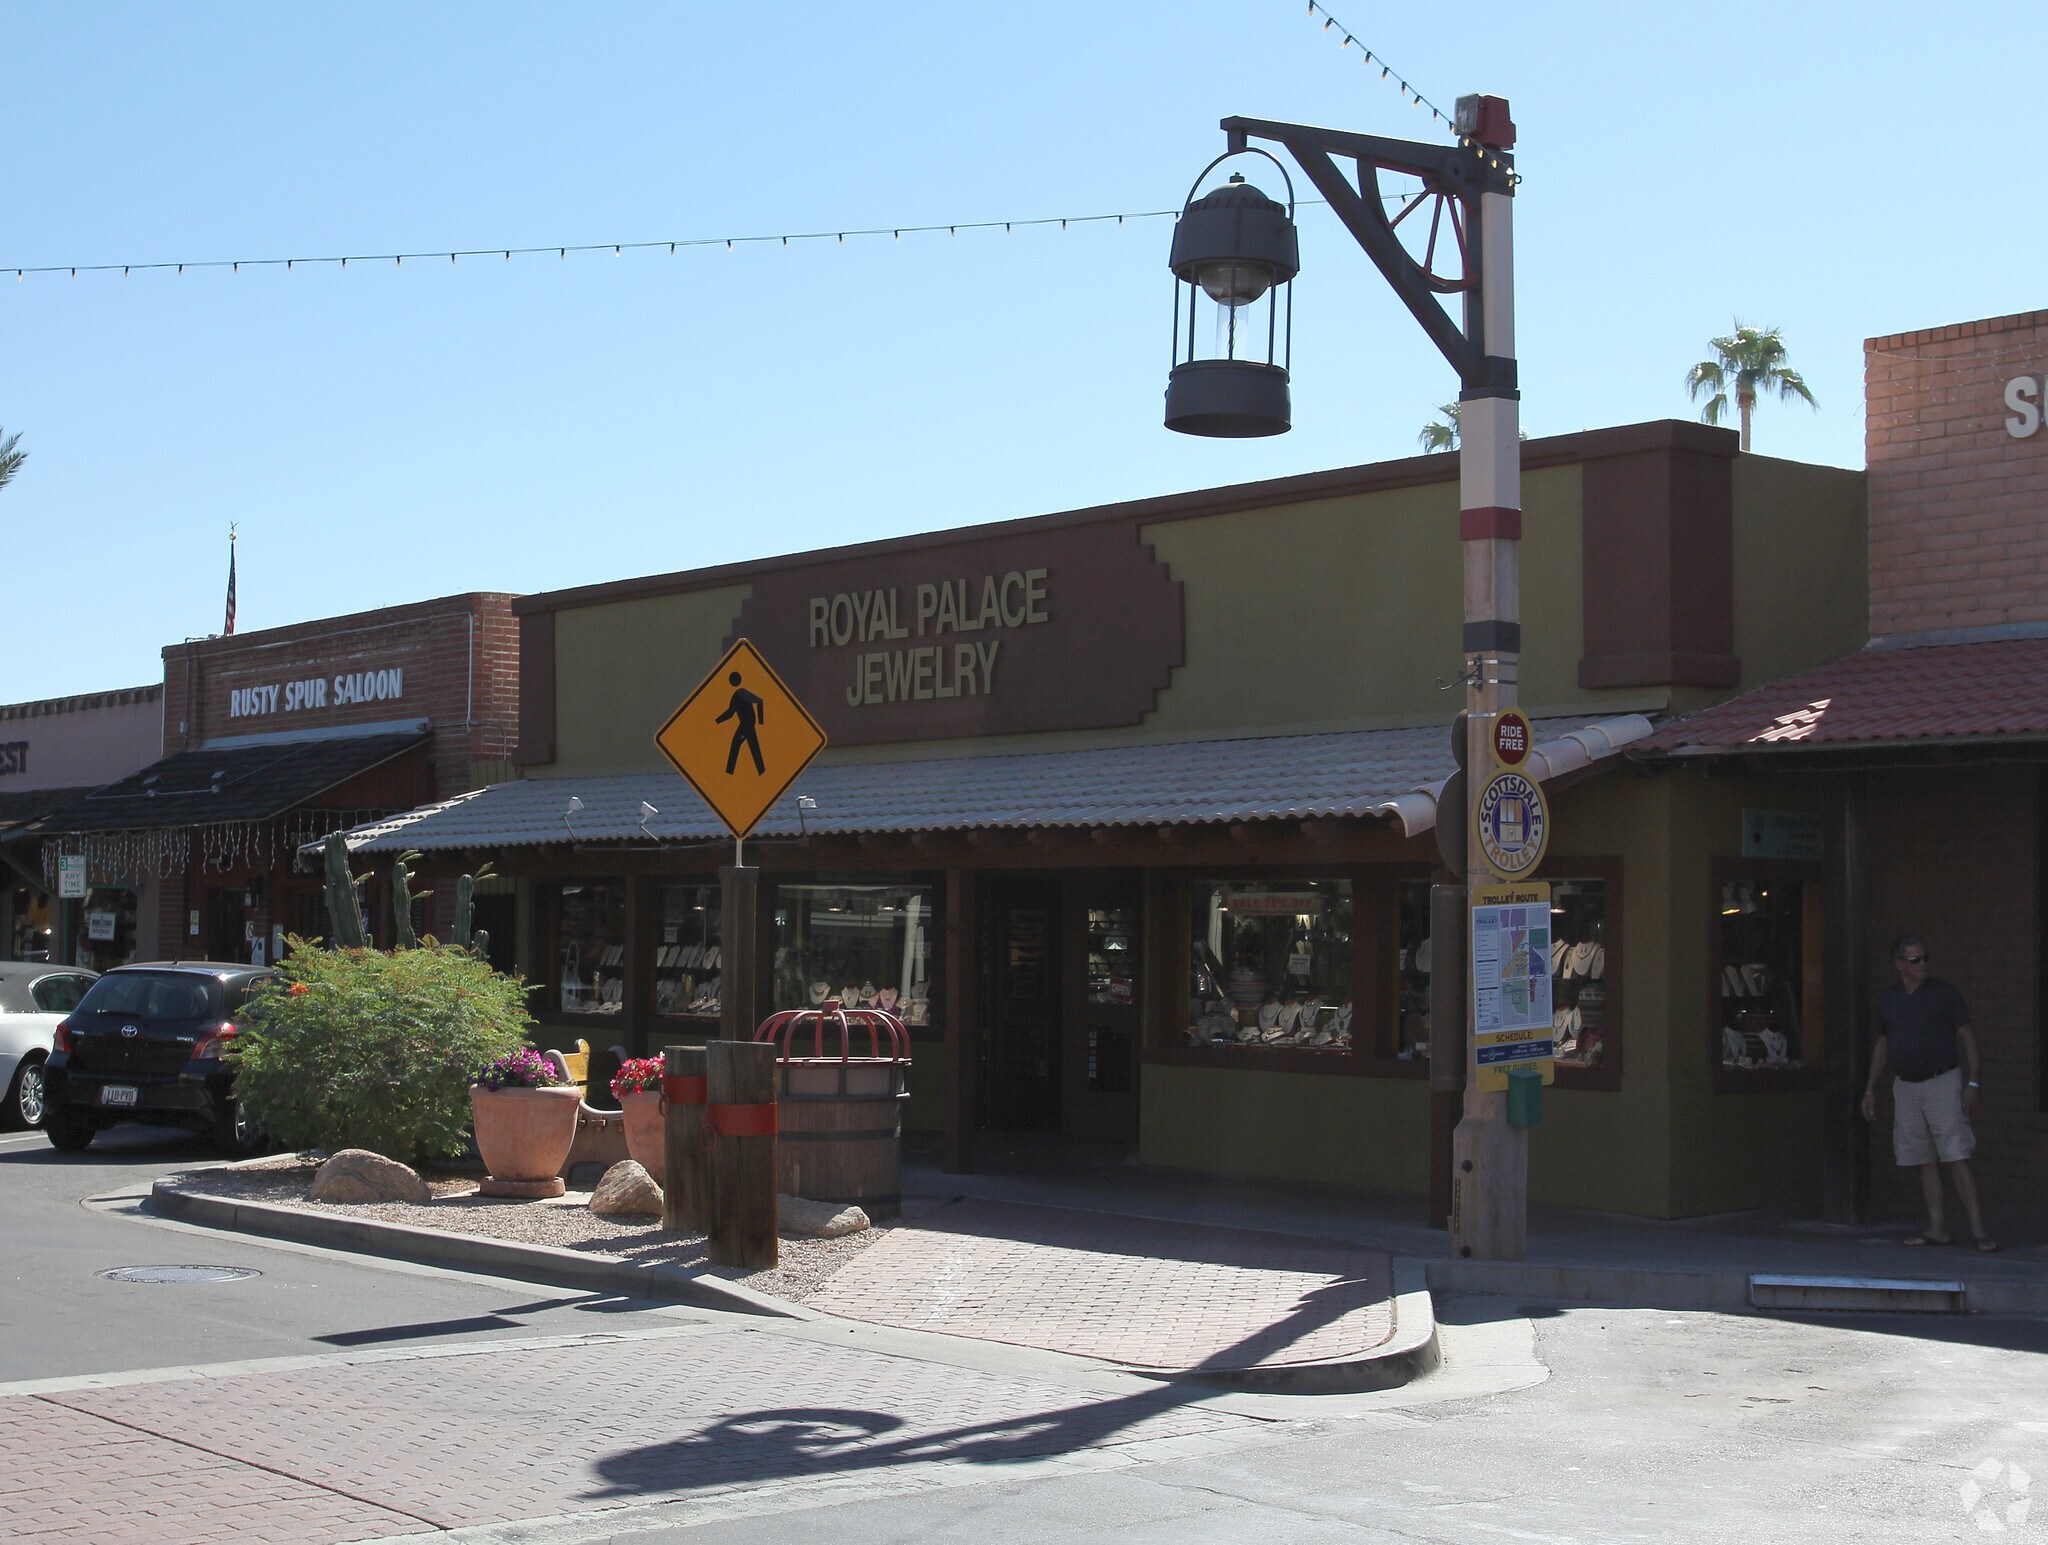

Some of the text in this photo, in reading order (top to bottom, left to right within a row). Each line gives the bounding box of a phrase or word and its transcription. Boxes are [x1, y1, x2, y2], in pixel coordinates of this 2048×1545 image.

[810, 568, 1048, 648] ROYAL PALACE
[846, 641, 999, 707] JEWELRY
[230, 668, 403, 718] RUSTY SPUR SALOON
[1500, 725, 1522, 738] RIDE
[1499, 738, 1524, 751] FREE
[1481, 777, 1541, 826] SCOTTSDALE
[1485, 834, 1538, 869] TROLLEY
[61, 858, 67, 870] 3
[65, 872, 80, 880] ANY
[1483, 893, 1538, 904] TROLLEY ROUTE
[1111, 984, 1131, 996] OPEN
[1496, 1031, 1534, 1043] SCHEDULE:
[1494, 1065, 1510, 1074] FREE
